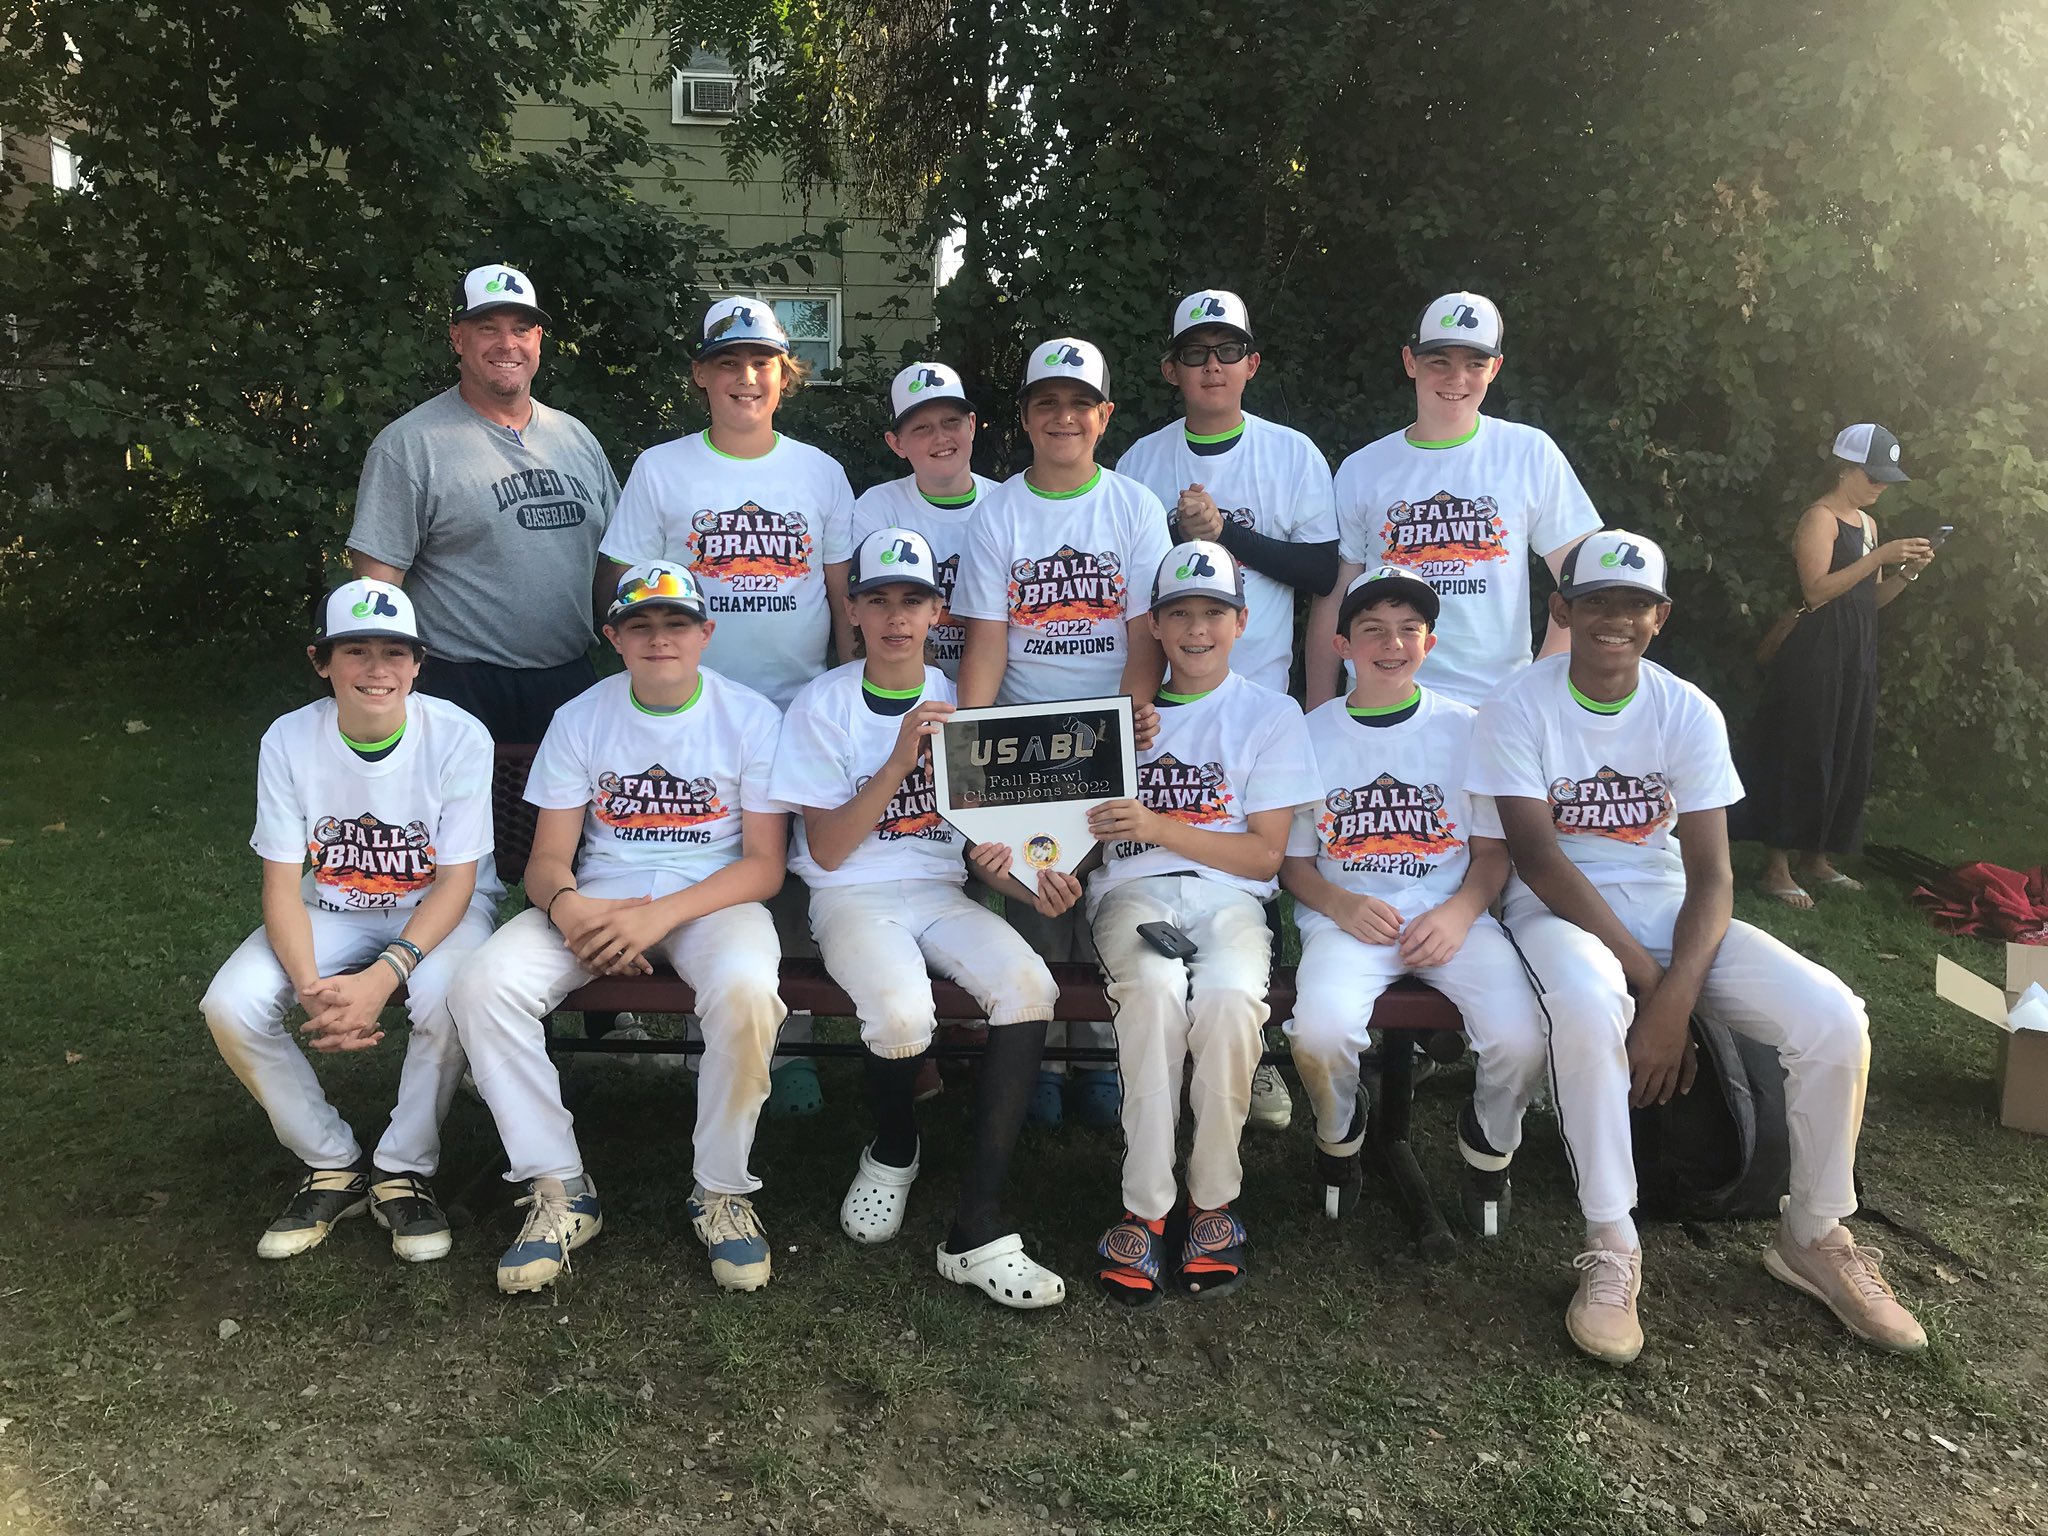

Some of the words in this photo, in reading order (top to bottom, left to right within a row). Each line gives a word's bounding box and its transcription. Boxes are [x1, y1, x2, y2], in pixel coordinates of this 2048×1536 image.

[491, 468, 565, 513] LOCKED
[564, 474, 595, 506] IN
[524, 503, 581, 528] BASEBALL
[1413, 501, 1475, 521] FALL
[720, 514, 787, 532] FALL
[1397, 520, 1494, 546] BRAWL
[704, 534, 803, 558] BRAWL
[1038, 556, 1098, 580] FALL
[1422, 561, 1465, 577] 2022
[732, 575, 778, 592] 2022
[1023, 577, 1115, 606] BRAWL
[1428, 579, 1487, 595] MPIONS
[710, 595, 797, 612] CHAMPIONS
[1046, 619, 1092, 637] 2022
[1023, 636, 1115, 655] CHAMPIONS
[970, 732, 1094, 766] USABL
[989, 775, 1023, 788] Fall
[1029, 770, 1083, 786] Brawl
[1138, 768, 1200, 786] FALL
[623, 778, 691, 800] FALL
[964, 786, 1062, 804] Champions
[1067, 780, 1110, 795] 2022
[1139, 787, 1215, 809] RAWL
[1354, 788, 1422, 809] FALL
[1579, 779, 1645, 802] FALL
[1340, 810, 1442, 837] BRAWL
[344, 822, 406, 848] FALL
[325, 844, 429, 873] BRAWL
[346, 888, 397, 908] 2022
[1195, 1219, 1229, 1242] KNICKS
[1110, 1232, 1144, 1256] KNICKS
